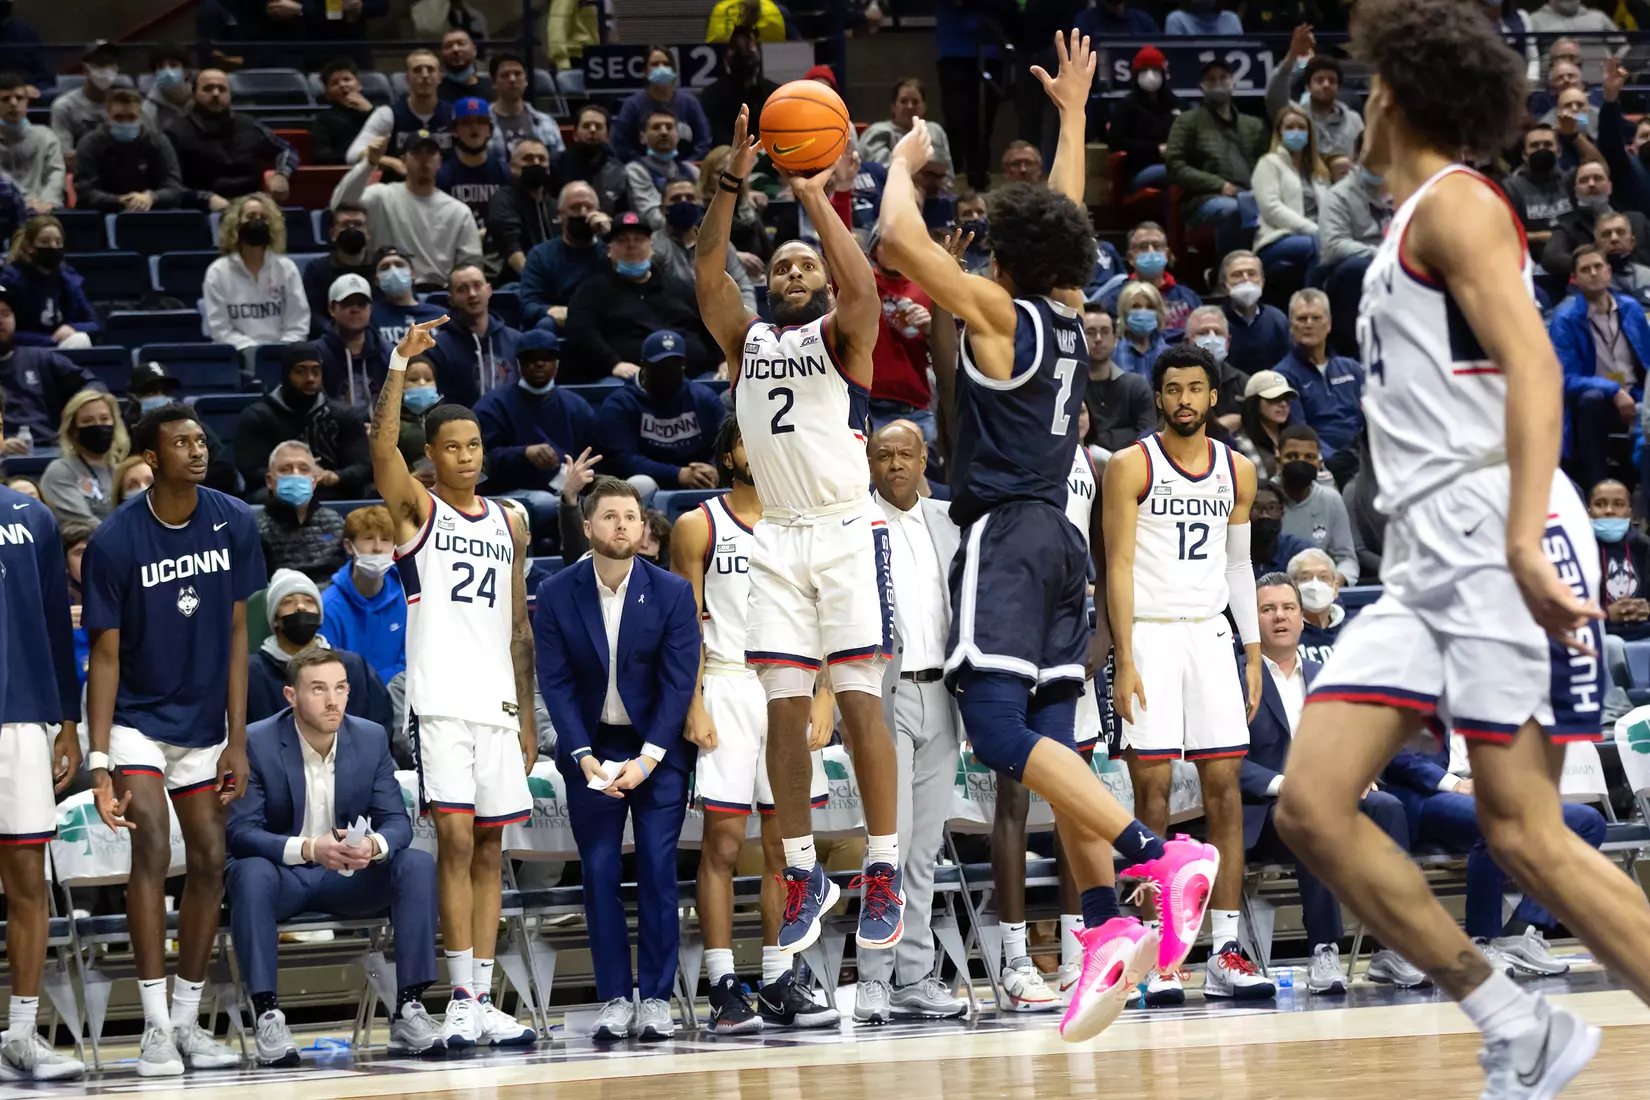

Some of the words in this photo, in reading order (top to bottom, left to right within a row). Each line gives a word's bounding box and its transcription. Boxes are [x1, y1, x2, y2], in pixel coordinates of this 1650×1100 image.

[588, 56, 645, 80] SEC
[228, 303, 282, 319] UCONN
[745, 355, 826, 379] UCONN
[1051, 358, 1078, 436] 2
[768, 387, 795, 434] 2
[643, 416, 698, 439] UCONN
[1151, 498, 1231, 518] UCONN
[435, 532, 512, 565] UCONN
[1176, 522, 1210, 560] 12
[141, 548, 230, 588] UCONN
[451, 561, 496, 608] 24
[532, 798, 569, 818] Sele
[534, 818, 571, 829] PHYSIC
